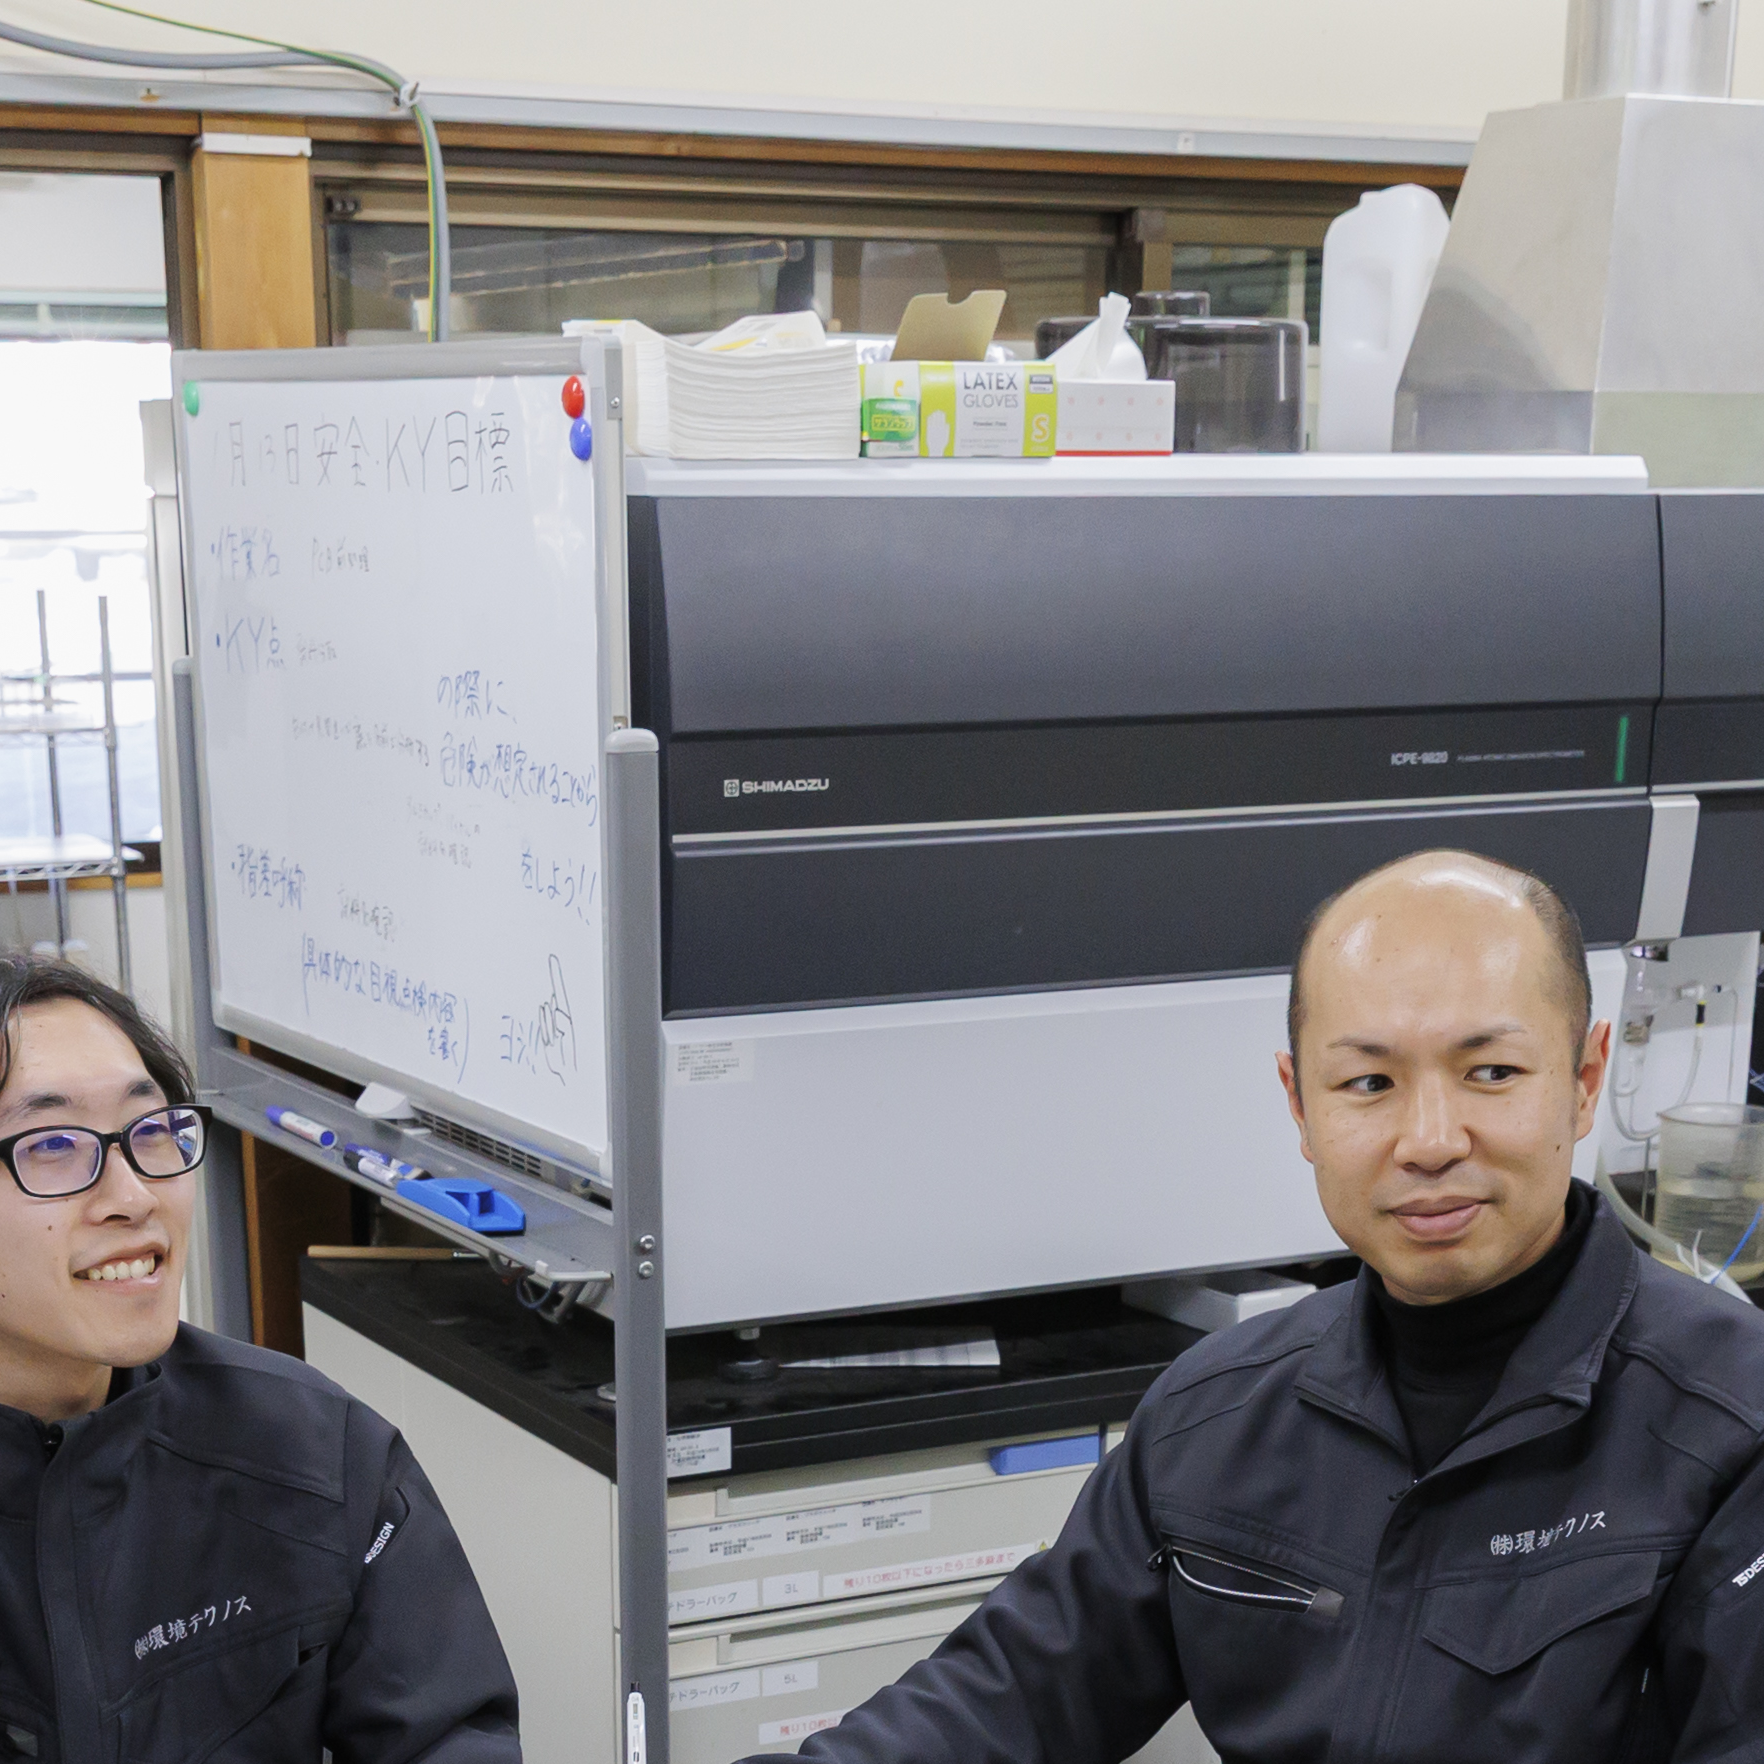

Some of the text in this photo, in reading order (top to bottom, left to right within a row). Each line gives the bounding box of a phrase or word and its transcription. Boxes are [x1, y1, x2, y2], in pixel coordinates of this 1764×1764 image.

[963, 371, 1018, 391] LATEX
[963, 393, 1019, 409] GLOVES
[1033, 415, 1049, 441] S
[741, 778, 829, 795] SHIMADZU
[784, 1583, 798, 1595] 3L
[784, 1674, 798, 1684] 5L
